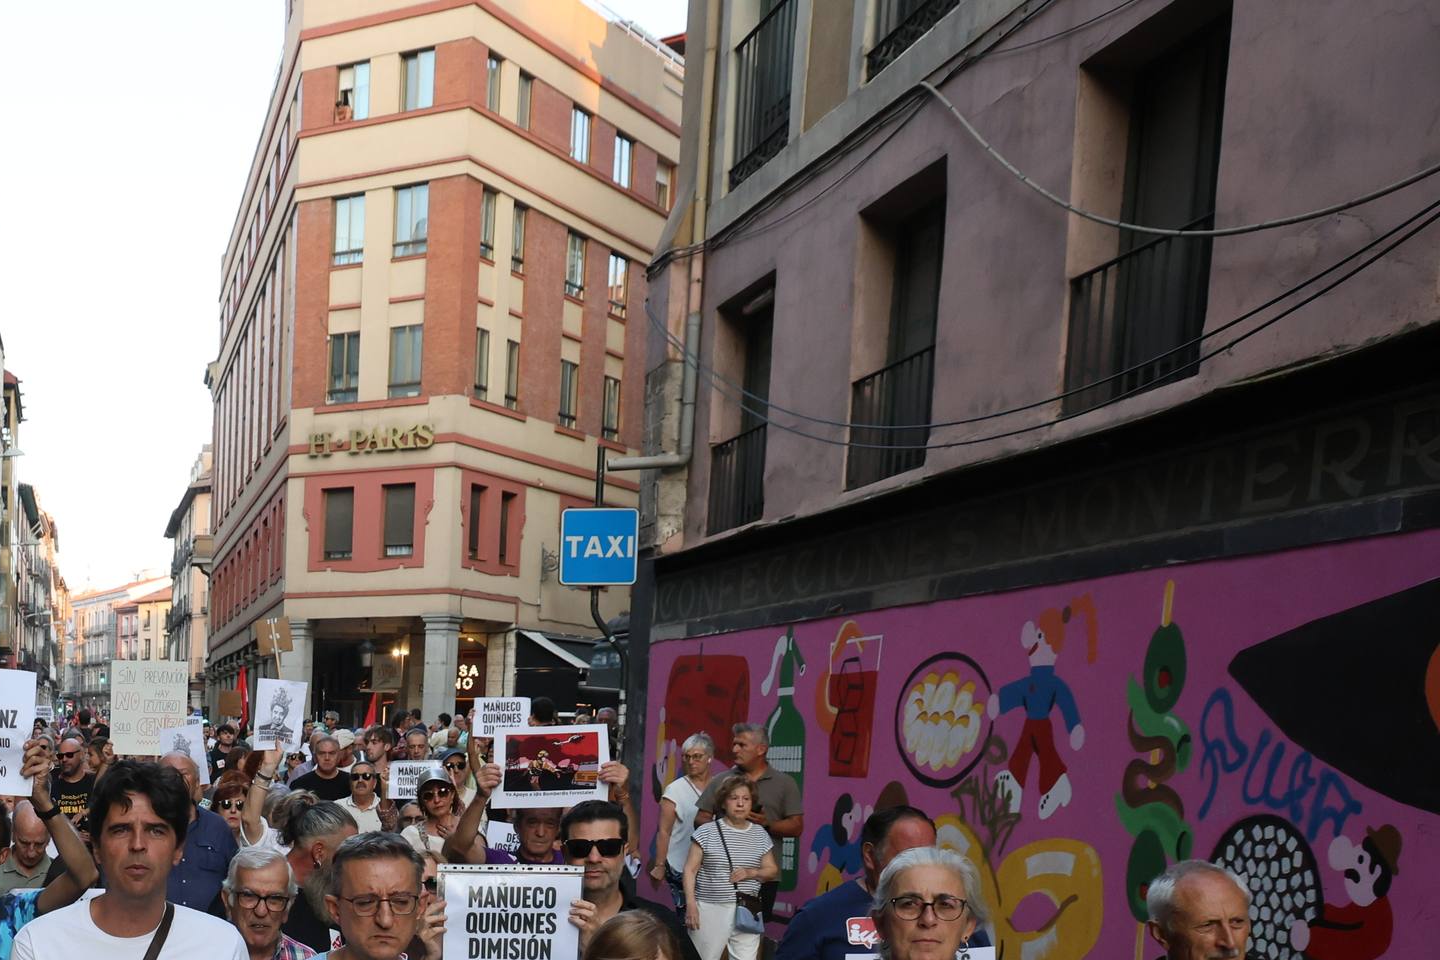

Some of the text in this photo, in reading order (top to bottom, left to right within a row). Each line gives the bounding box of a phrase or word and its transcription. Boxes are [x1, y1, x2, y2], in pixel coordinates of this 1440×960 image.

[566, 534, 634, 559] TAXI
[114, 692, 140, 711] NO
[483, 700, 521, 712] MAÑUECO
[482, 712, 522, 724] QUIÑONES
[468, 882, 557, 909] MAÑUECO
[466, 909, 557, 935] QUIÑONES
[468, 934, 552, 960] DIMISIÓN
